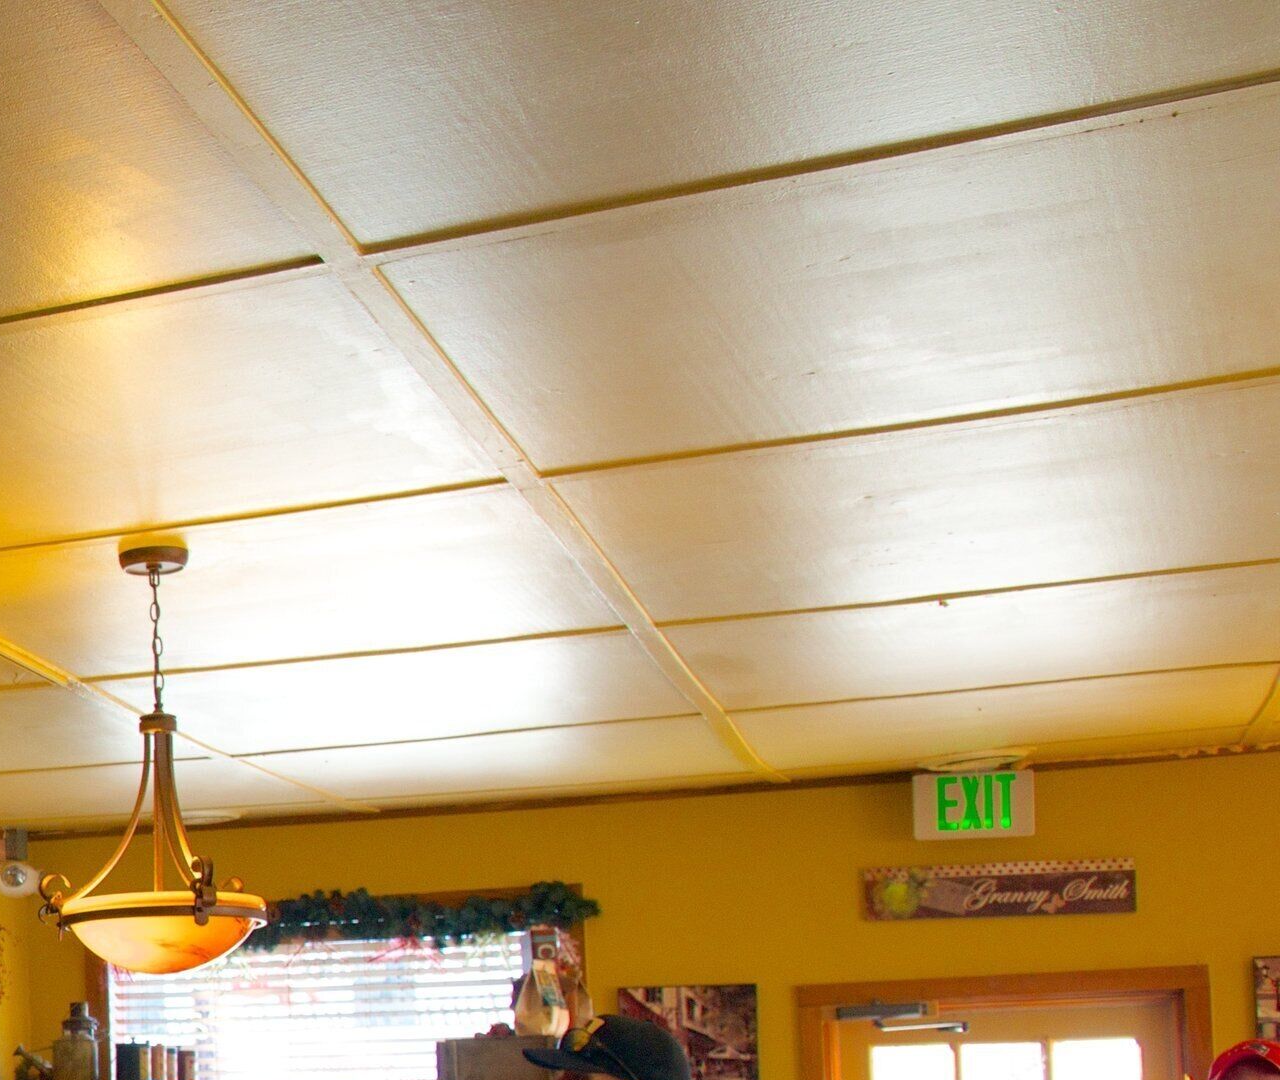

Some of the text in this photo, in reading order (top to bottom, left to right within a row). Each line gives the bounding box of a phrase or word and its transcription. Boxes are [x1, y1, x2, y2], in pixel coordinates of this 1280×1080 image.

[935, 773, 1017, 832] EXIT
[963, 877, 1130, 912] Granny Smith
